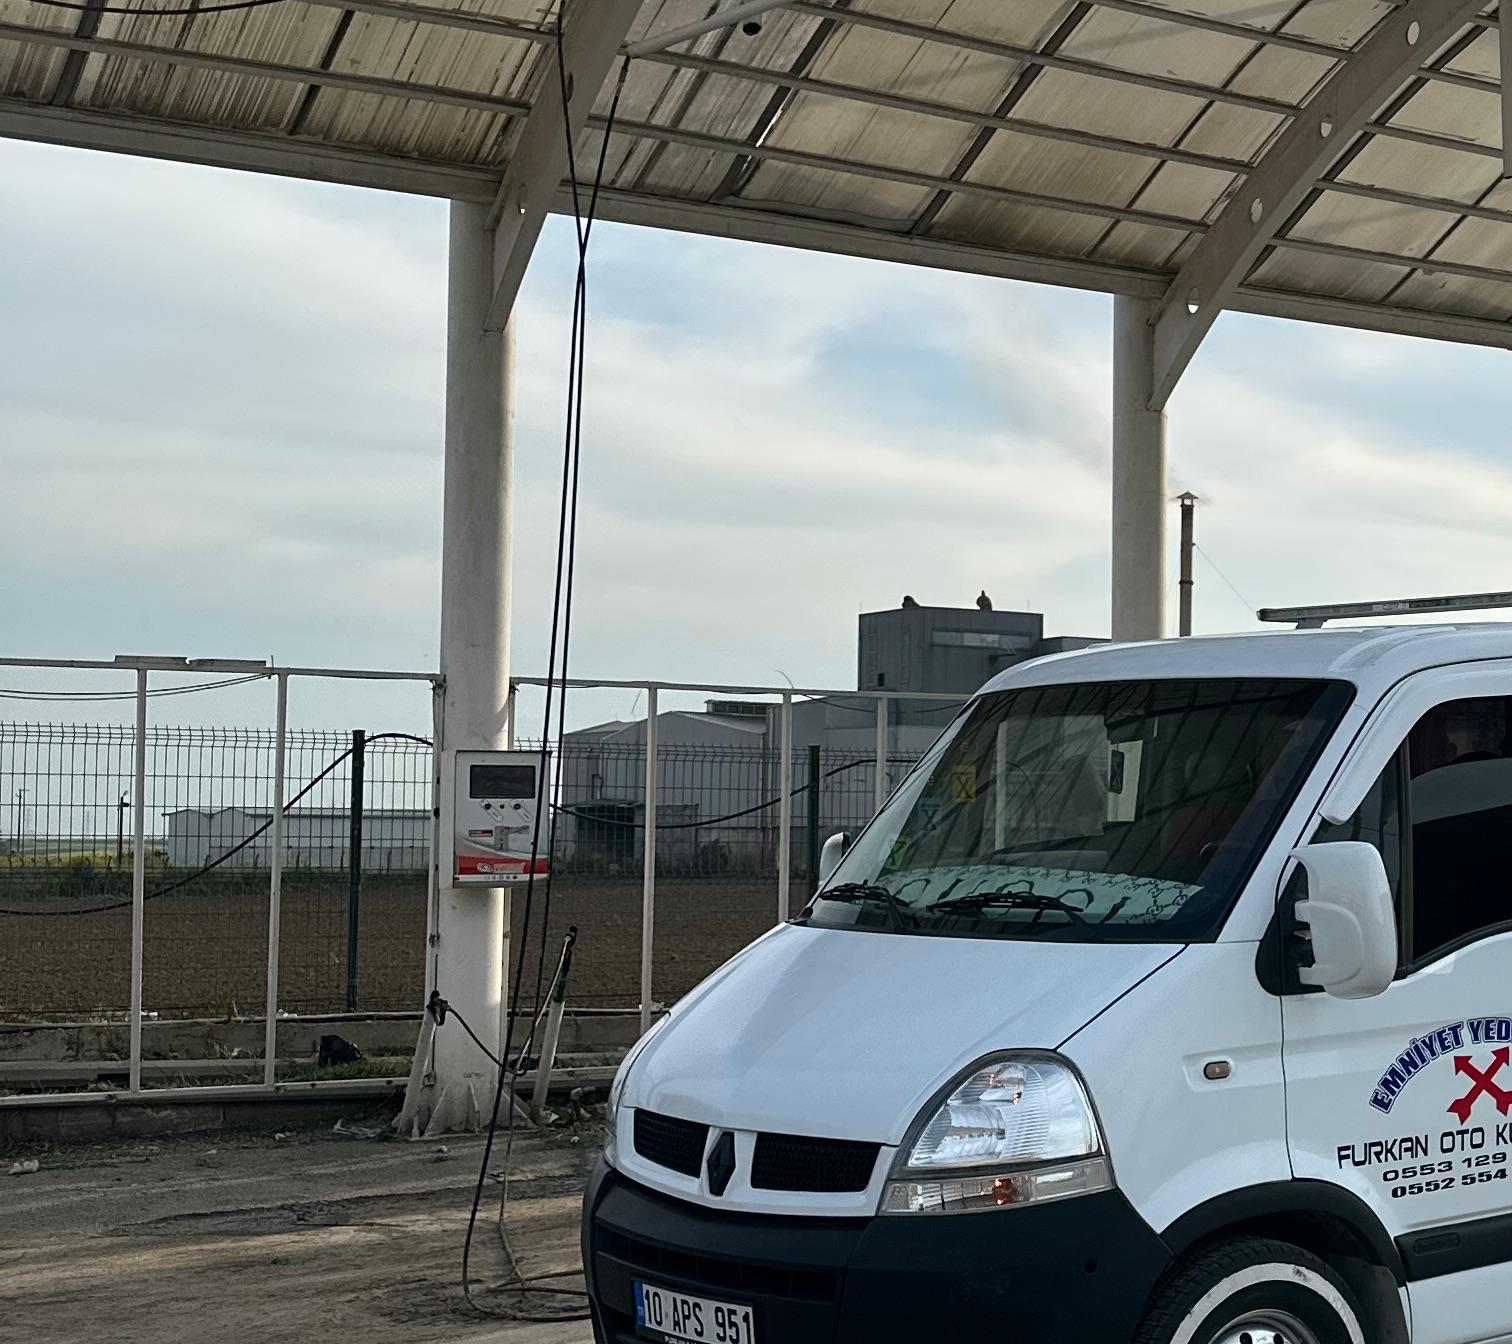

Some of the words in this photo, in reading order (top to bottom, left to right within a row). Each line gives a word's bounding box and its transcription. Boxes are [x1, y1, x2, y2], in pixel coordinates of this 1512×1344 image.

[1369, 1021, 1464, 1114] EMNİYET
[1337, 1135, 1428, 1169] FURKAN
[1440, 1127, 1485, 1154] OTO
[1383, 1160, 1453, 1182] 0553
[1462, 1152, 1507, 1168] 129
[1391, 1177, 1455, 1198] 0552
[1461, 1168, 1508, 1185] 554
[645, 1290, 663, 1327] 10
[672, 1297, 704, 1337] APS
